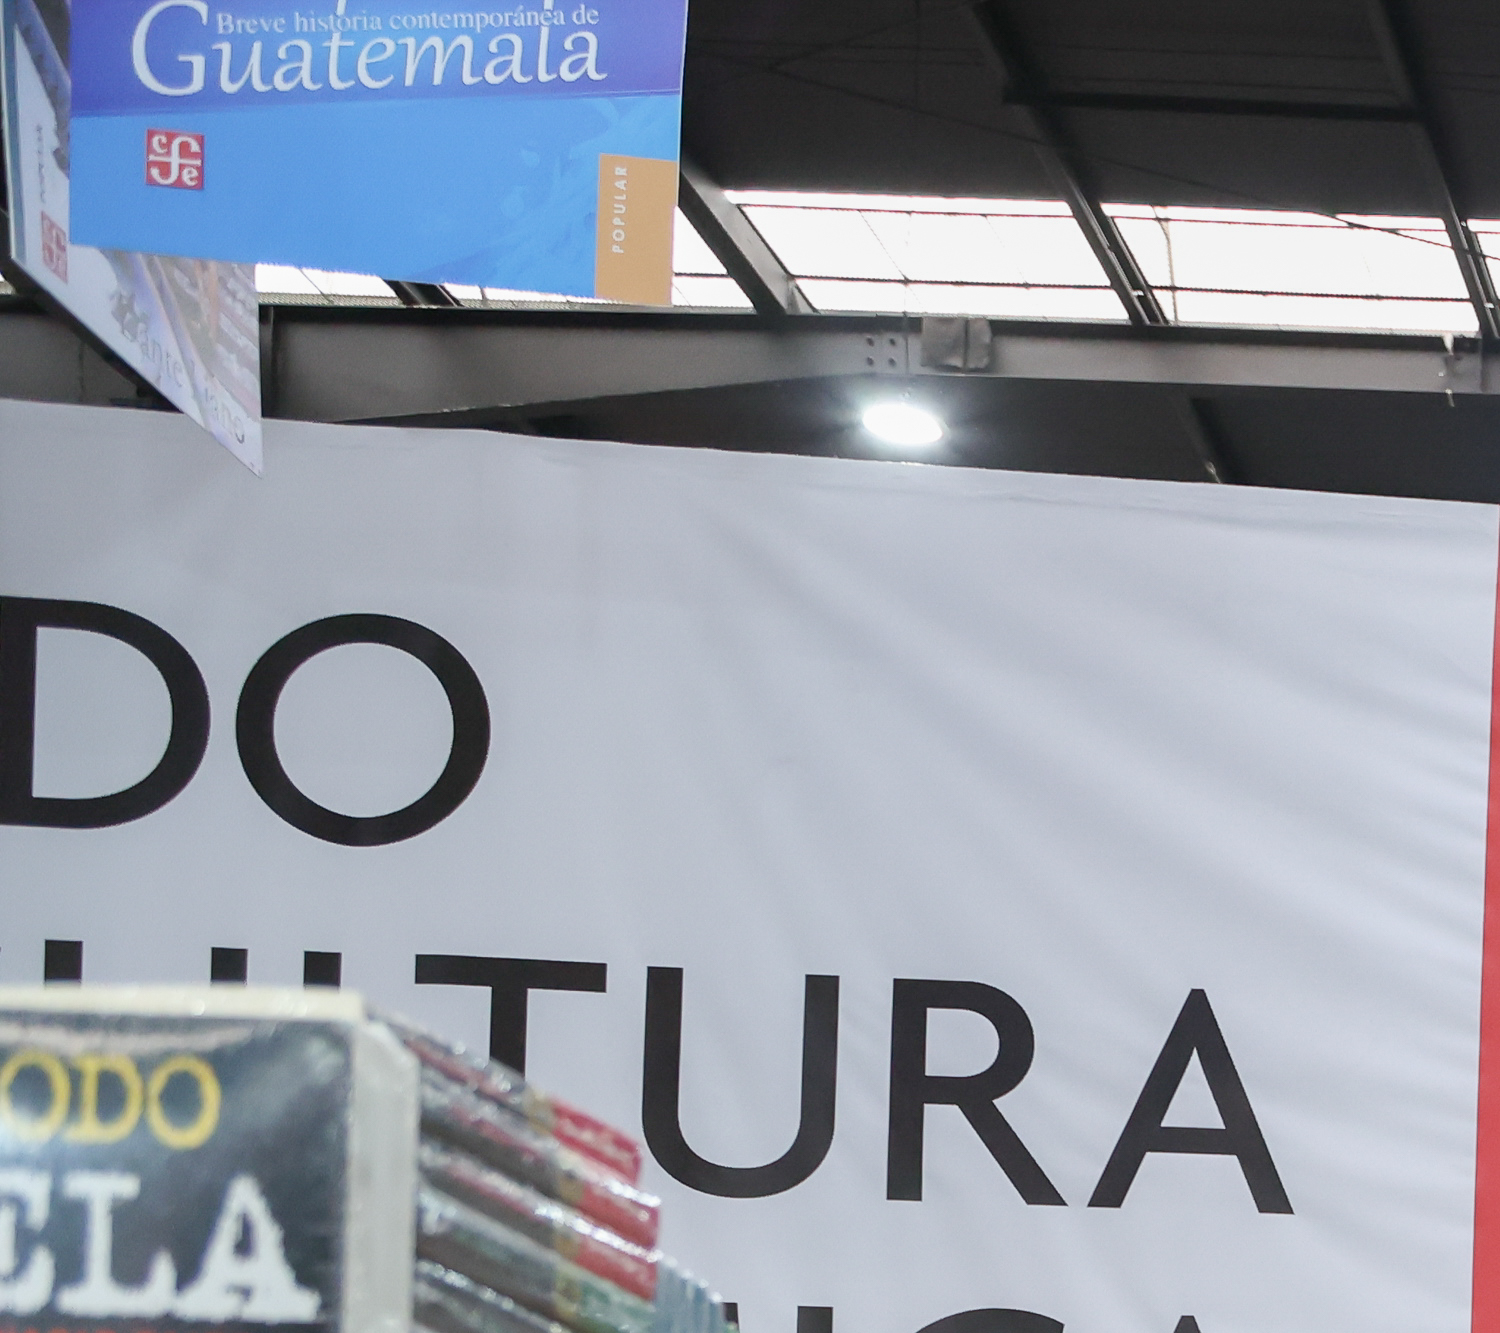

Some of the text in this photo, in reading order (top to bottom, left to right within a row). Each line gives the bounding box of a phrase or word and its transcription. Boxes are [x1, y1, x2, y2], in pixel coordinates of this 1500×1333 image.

[131, 0, 609, 97] Guatemala
[216, 2, 601, 36] Breve historia contemporánea de
[611, 164, 628, 254] POPULAR
[0, 596, 491, 848] DO
